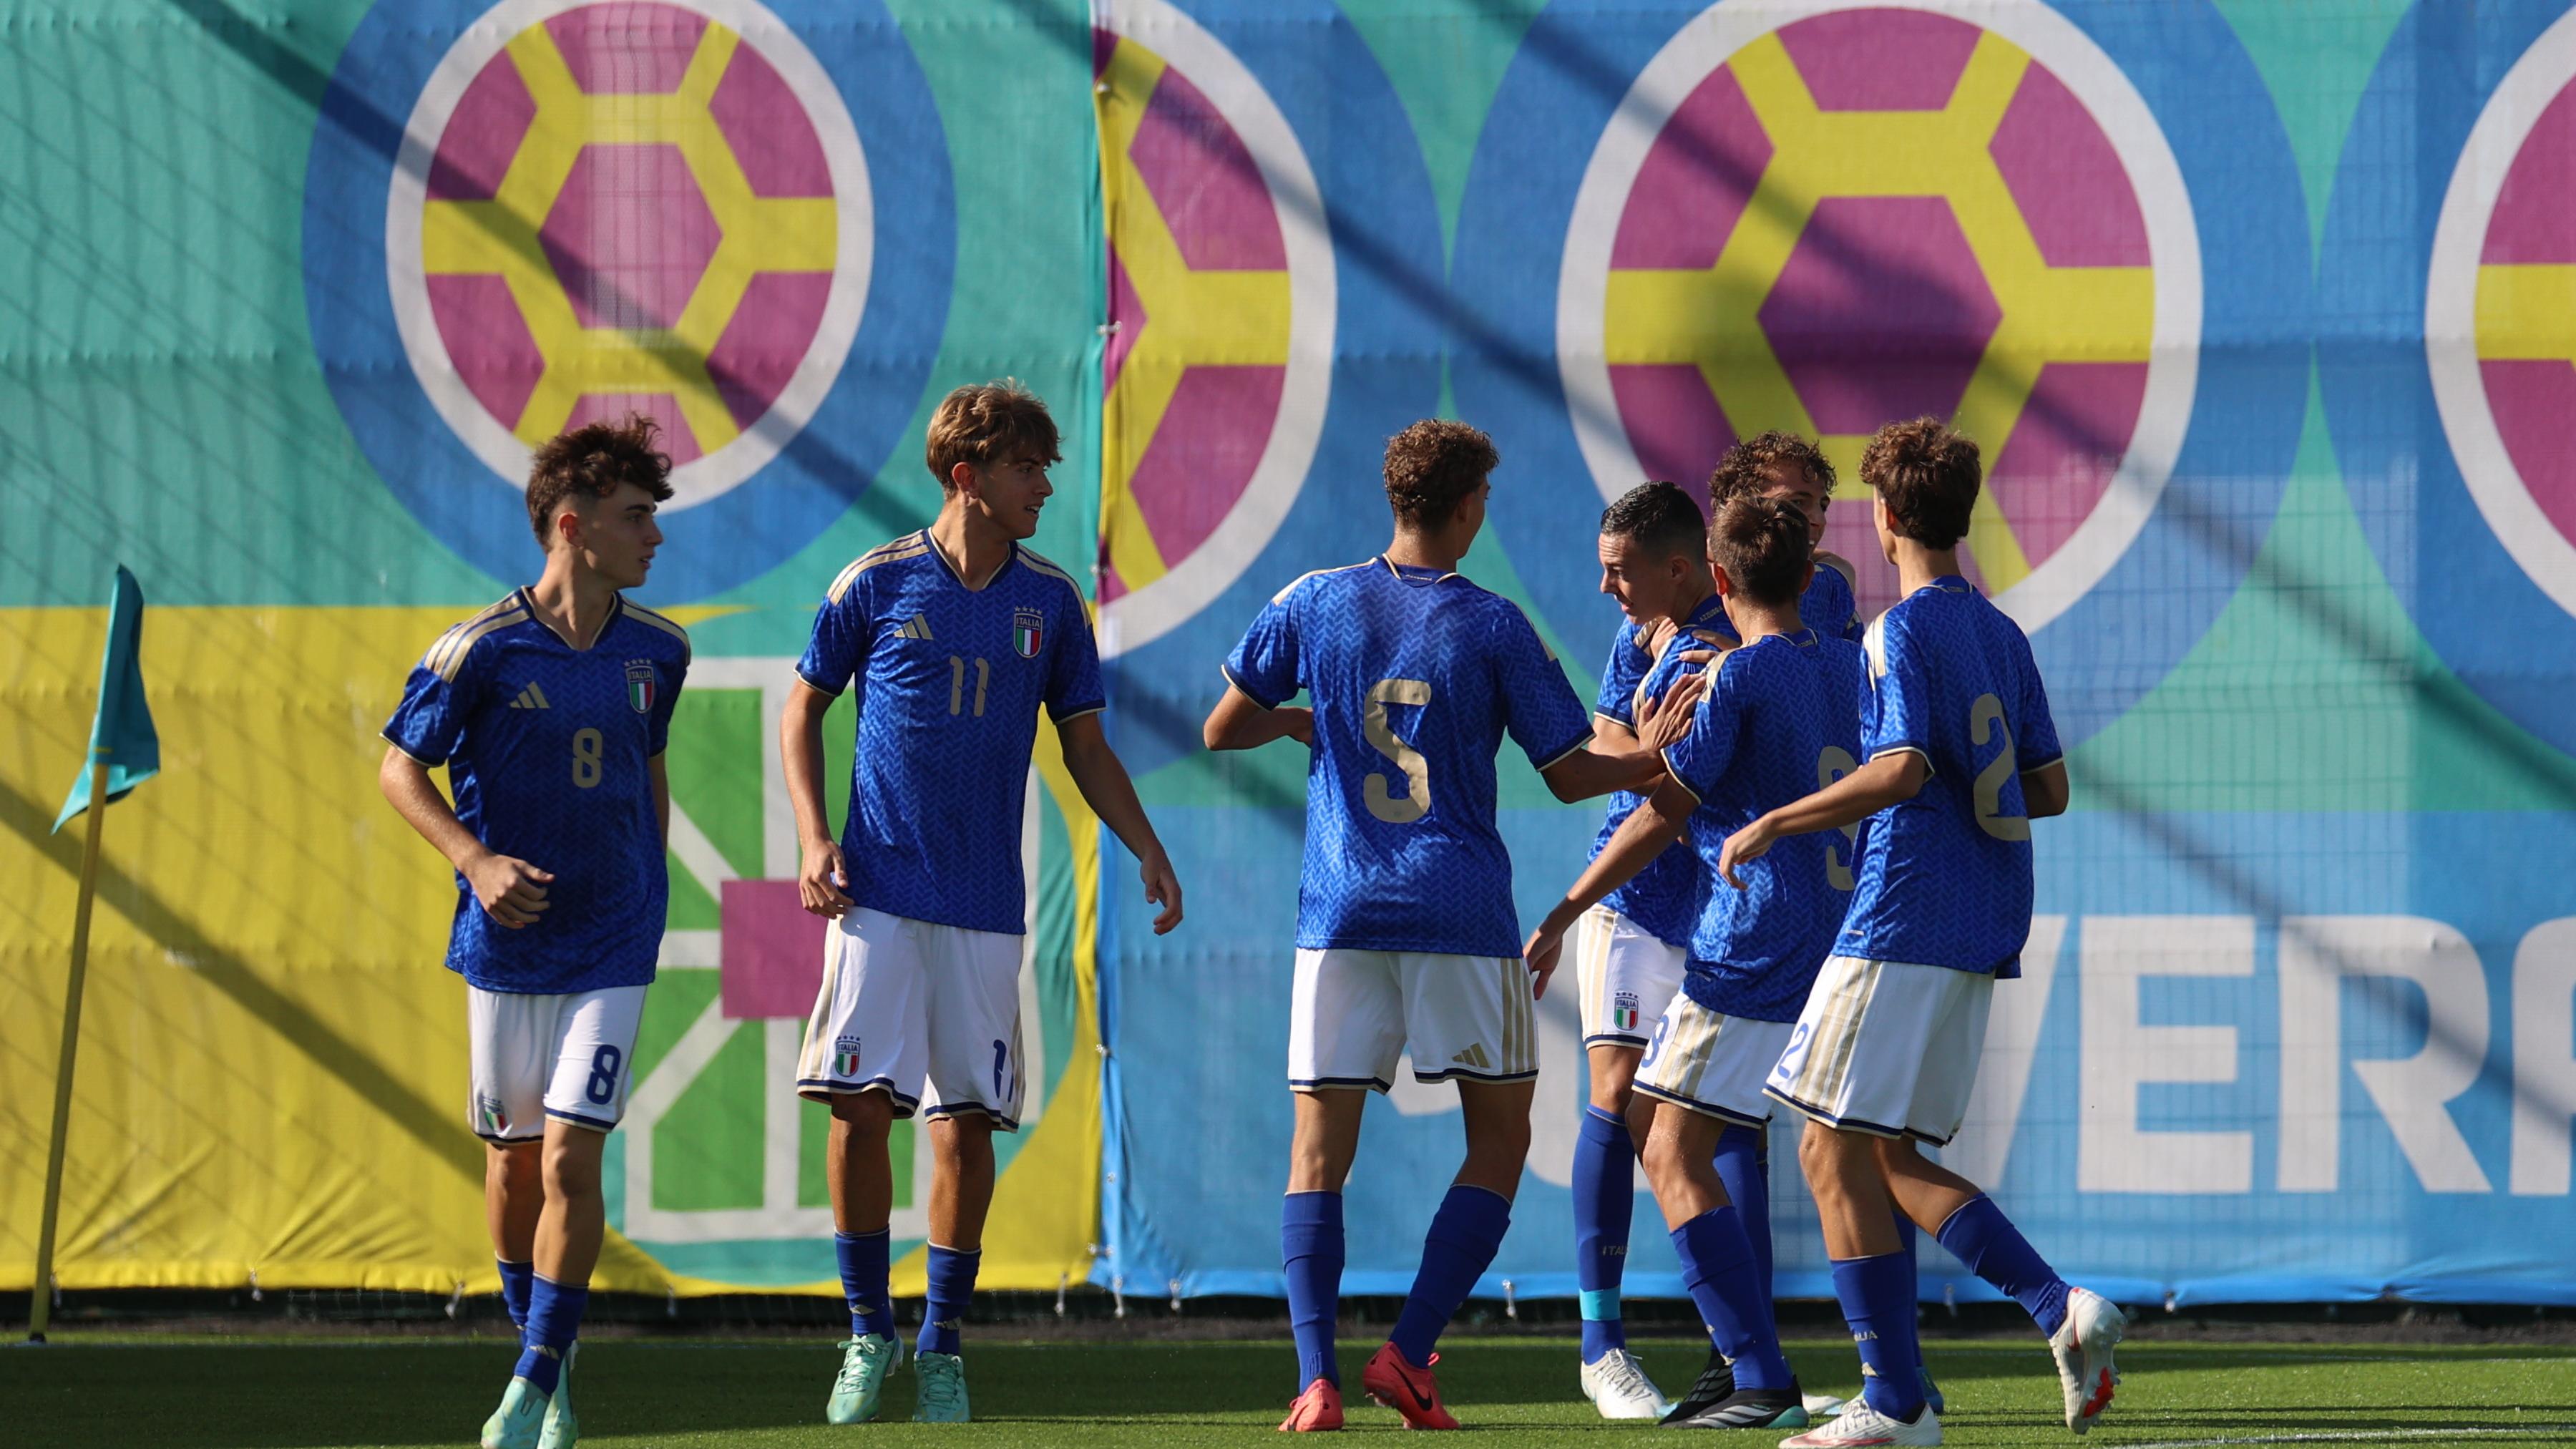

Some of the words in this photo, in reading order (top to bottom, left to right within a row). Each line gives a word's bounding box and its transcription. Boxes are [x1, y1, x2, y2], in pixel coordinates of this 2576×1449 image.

[1016, 617, 1040, 628] ITALIA
[629, 670, 652, 680] ITALIA
[950, 655, 990, 717] 11
[572, 726, 602, 789] 8
[1363, 678, 1432, 824] 5
[1971, 693, 2031, 841] 2
[1617, 999, 1636, 1008] ITALIA
[586, 1044, 621, 1106] 8
[838, 1043, 858, 1052] ITALIA
[1777, 1023, 1809, 1079] 2
